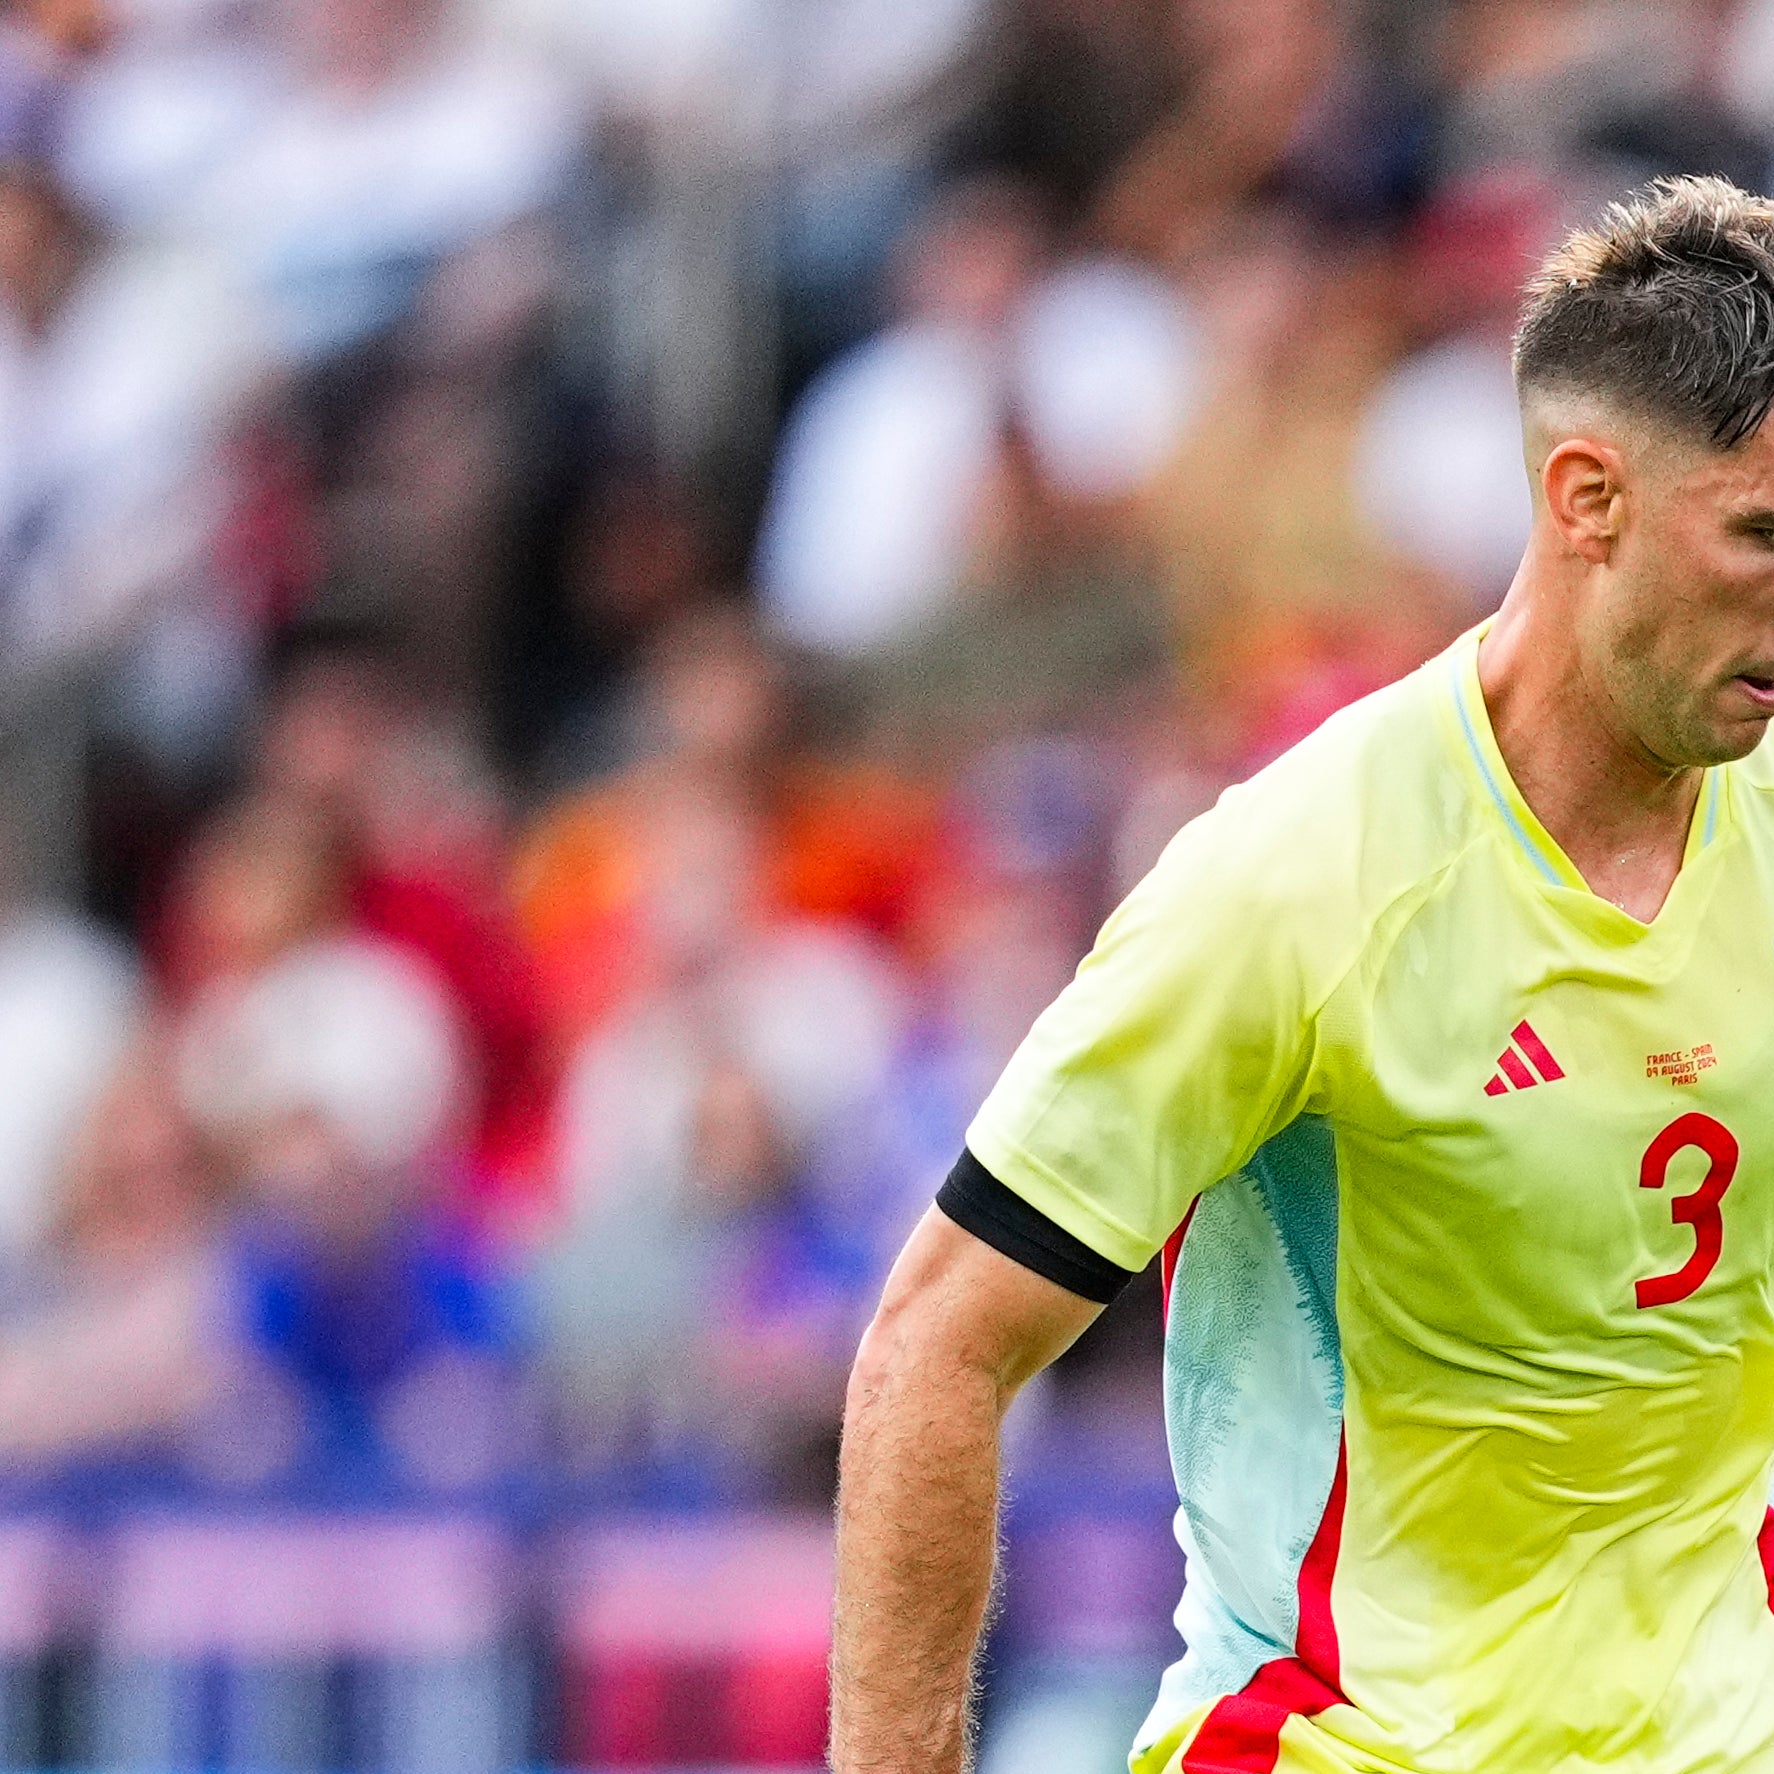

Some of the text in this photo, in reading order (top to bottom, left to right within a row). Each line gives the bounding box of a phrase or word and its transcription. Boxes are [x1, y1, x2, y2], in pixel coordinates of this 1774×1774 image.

[1646, 1051, 1682, 1065] FRANCE
[1691, 1044, 1713, 1058] SPAIN
[1646, 1056, 1717, 1078] 09 AUGUST 2024
[1671, 1073, 1698, 1086] PARIS
[1635, 1112, 1740, 1310] 3
